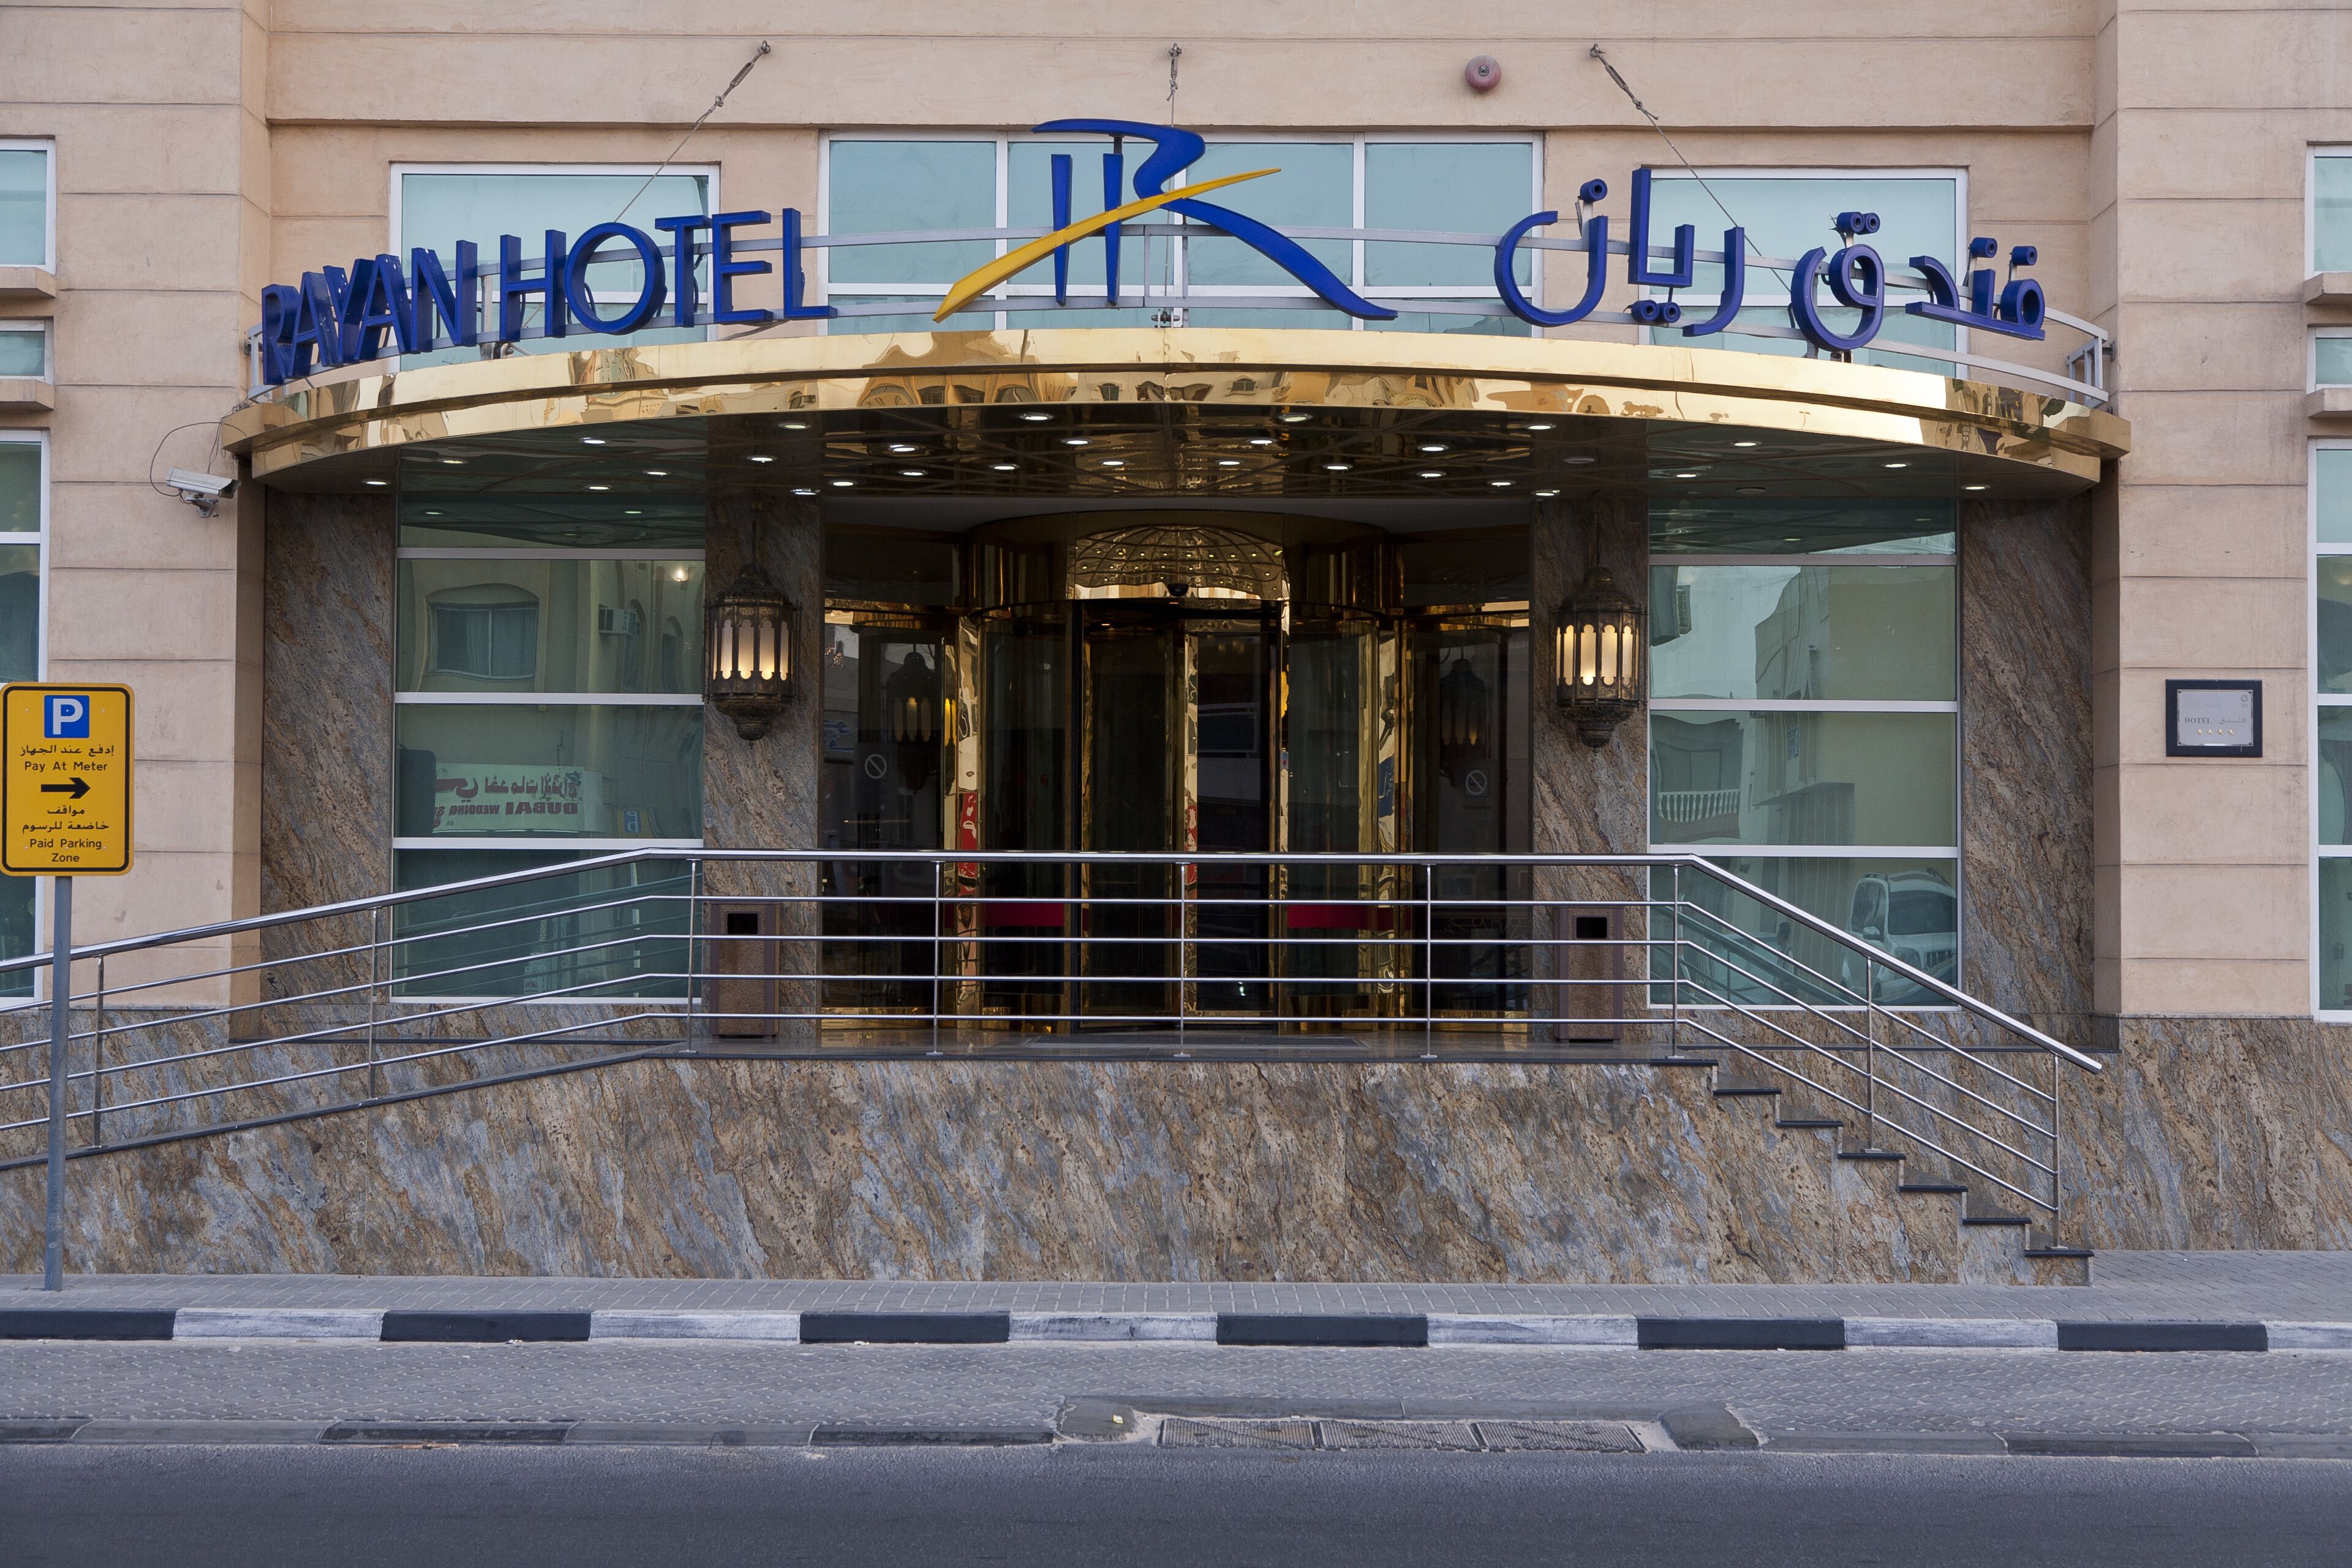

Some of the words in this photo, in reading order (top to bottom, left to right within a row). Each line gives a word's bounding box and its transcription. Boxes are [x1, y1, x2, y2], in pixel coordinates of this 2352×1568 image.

[1494, 167, 1745, 338] ريان
[1791, 210, 2046, 352] فندق
[262, 239, 478, 385] RAYAN
[499, 208, 837, 342] HOTEL
[53, 698, 83, 735] P
[20, 745, 56, 756] الجهاز
[61, 745, 81, 753] عند
[88, 744, 114, 756] إدفع
[24, 761, 45, 772] Pay
[53, 761, 67, 771] At
[74, 761, 108, 771] Meter
[47, 805, 85, 816] مواقف
[22, 821, 62, 834] للرسوم
[67, 821, 110, 830] خاضعة
[30, 839, 53, 848] Paid
[61, 839, 102, 850] Parking
[51, 853, 80, 862] Zone
